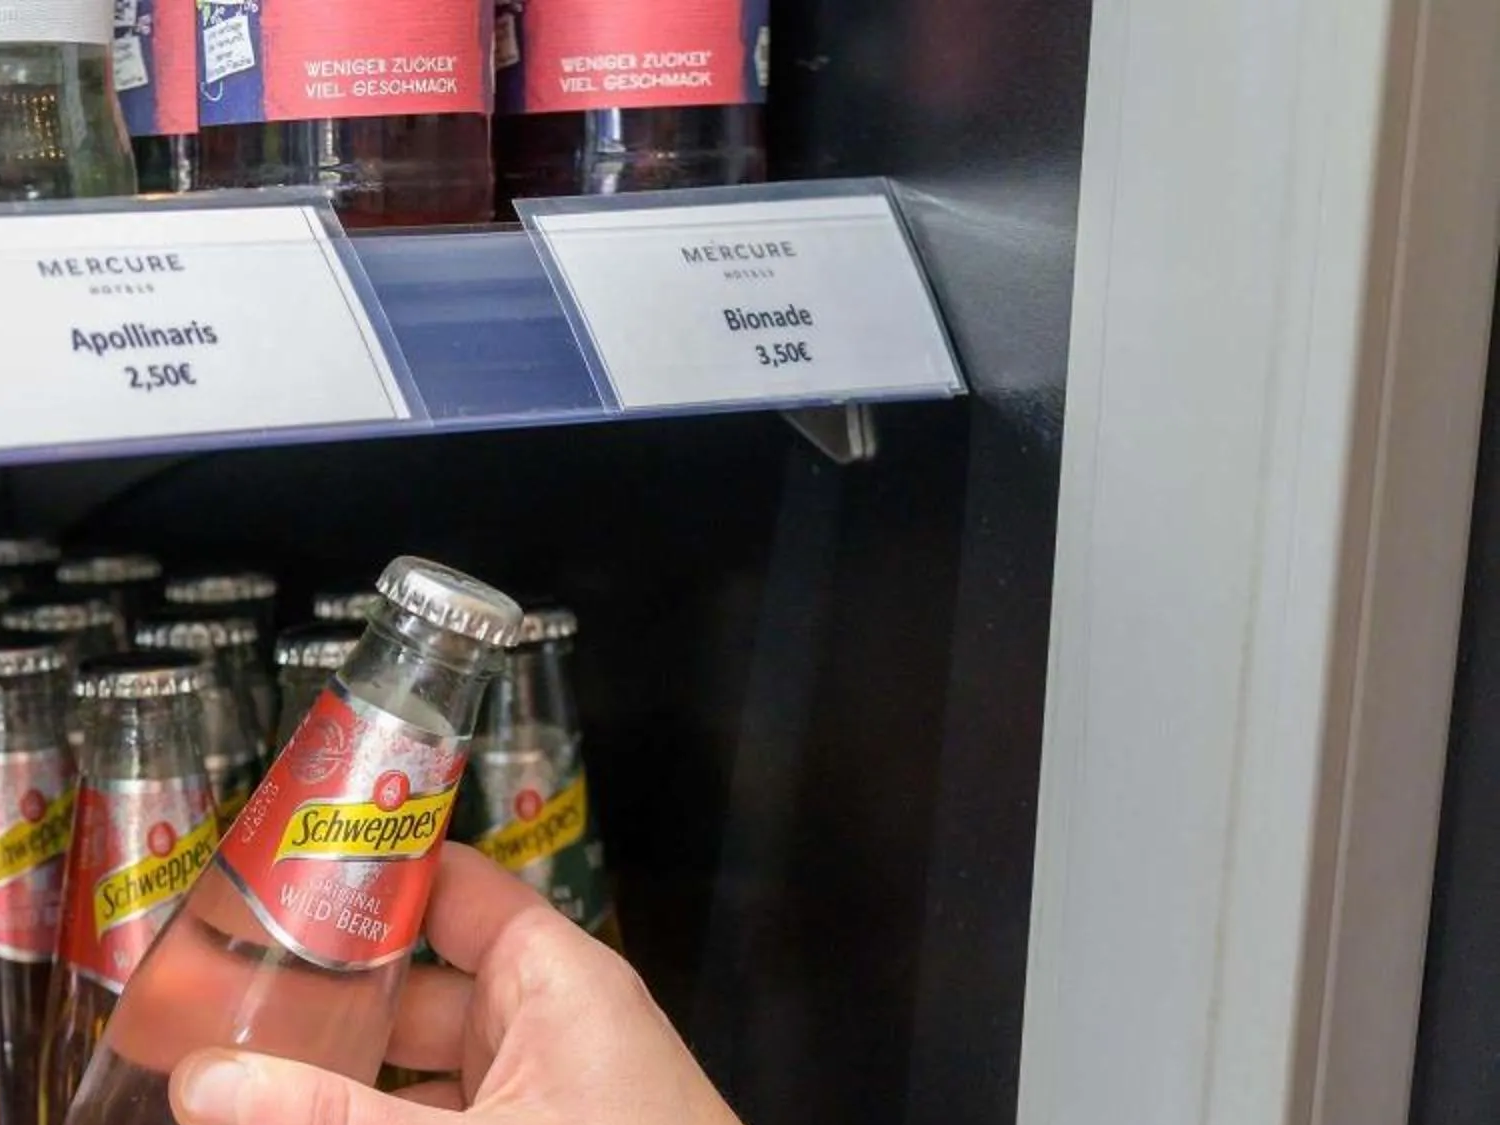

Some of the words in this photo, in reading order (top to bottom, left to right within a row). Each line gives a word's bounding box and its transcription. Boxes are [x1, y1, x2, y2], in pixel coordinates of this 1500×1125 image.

[304, 58, 386, 78] WENIGER
[560, 76, 598, 93] VIEL
[603, 71, 713, 91] GESCHMACK
[305, 81, 347, 99] VIEL
[352, 77, 457, 97] GESCHMACK
[37, 253, 186, 278] MERCURE
[679, 240, 798, 264] MERCURE
[723, 303, 813, 332] Bionade
[71, 320, 219, 357] Apollinaris
[755, 340, 813, 368] 3,50€
[123, 362, 198, 393] 2,50€
[292, 806, 442, 851] Schweppes
[279, 884, 332, 922] WILD
[336, 910, 393, 944] BERRY
